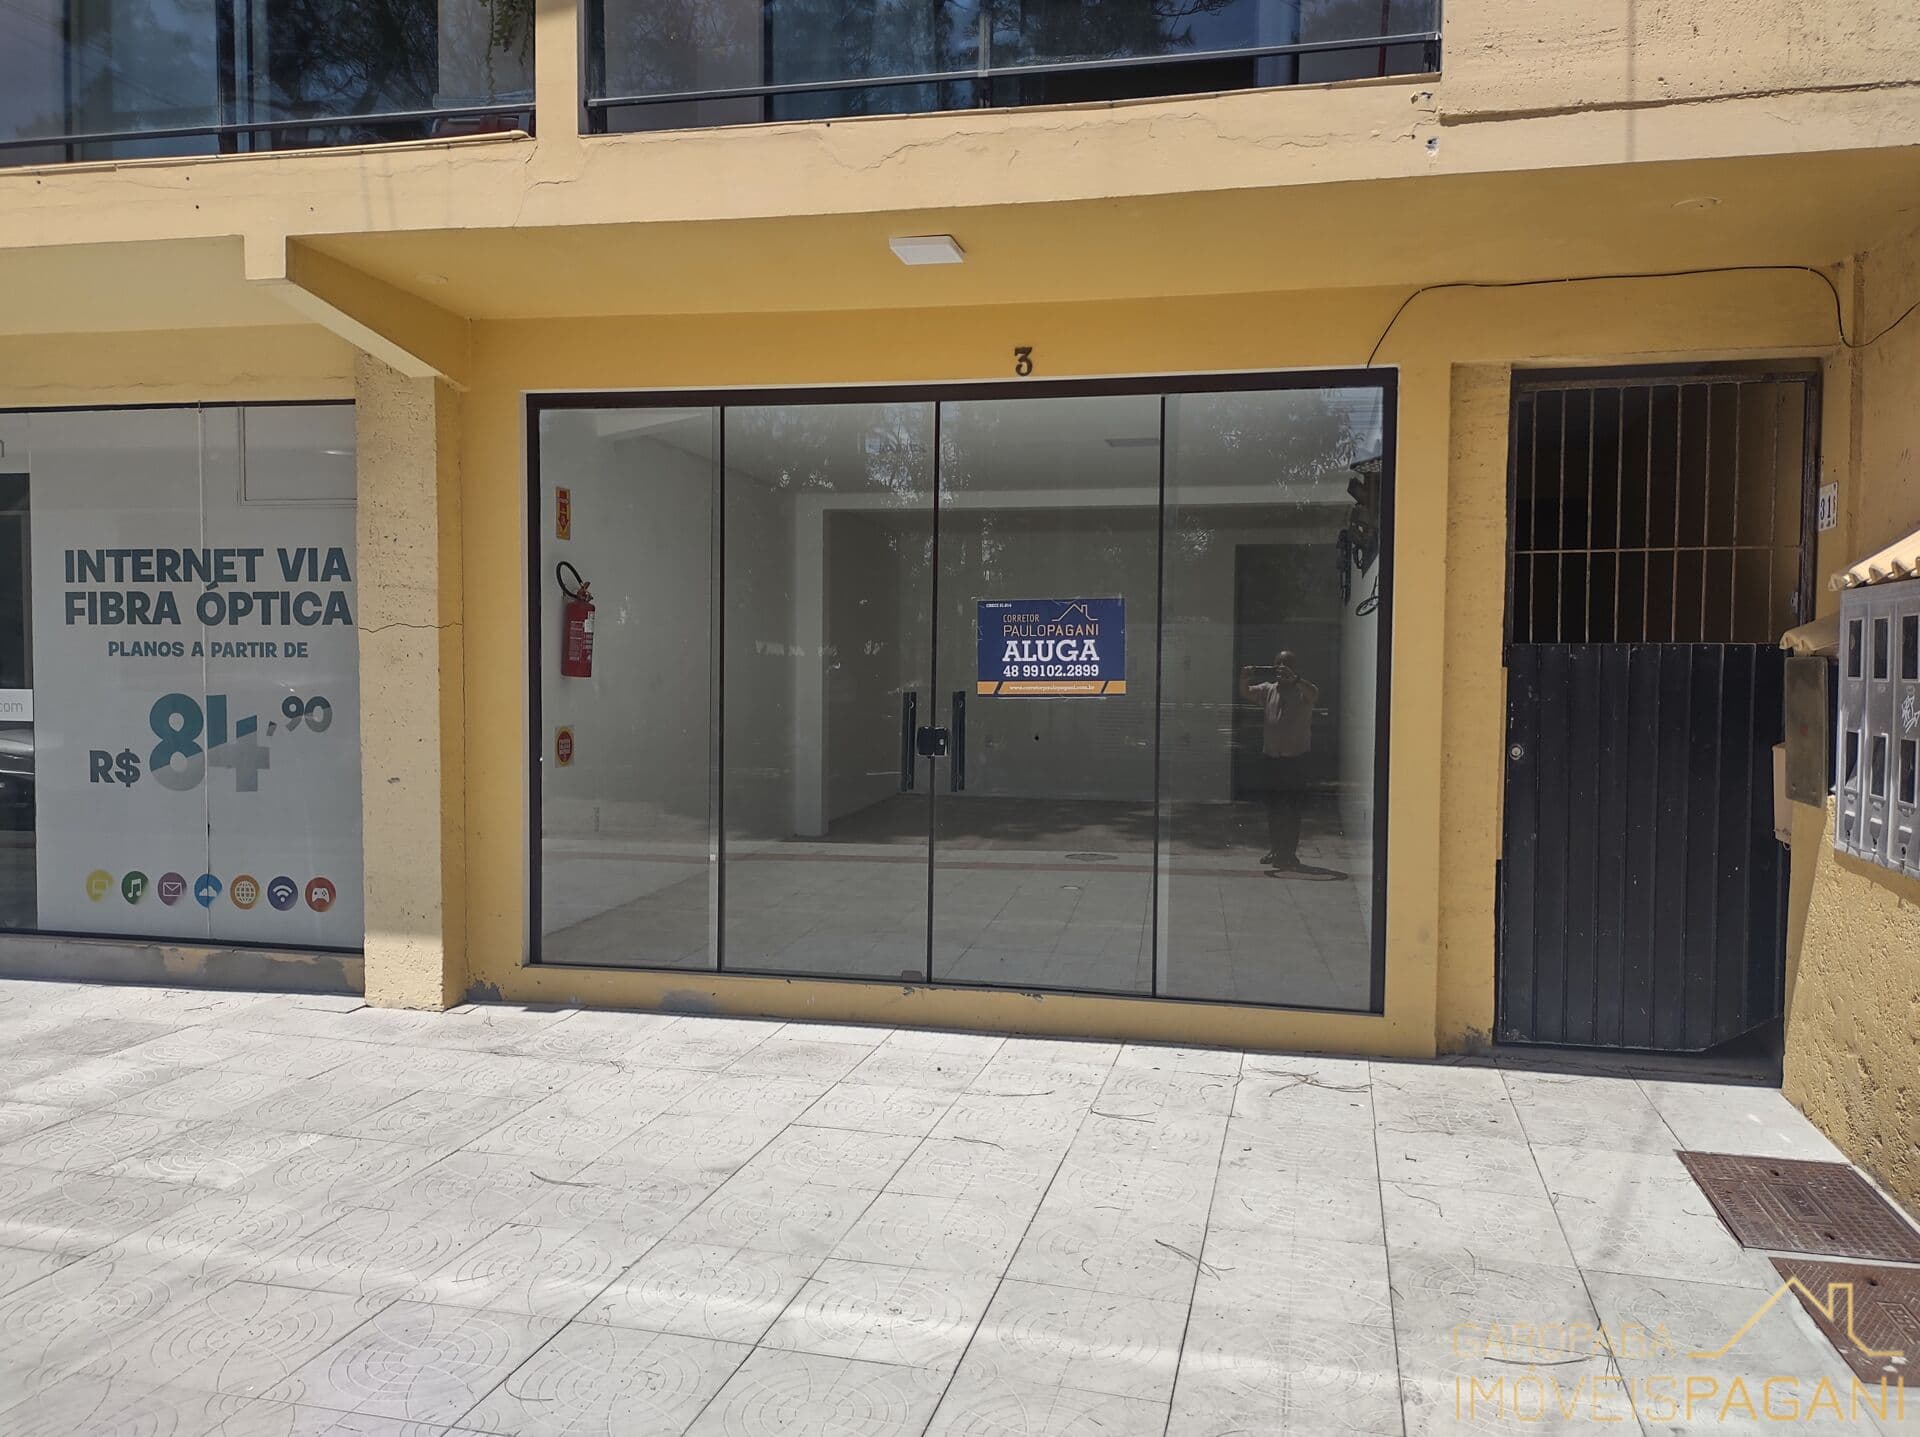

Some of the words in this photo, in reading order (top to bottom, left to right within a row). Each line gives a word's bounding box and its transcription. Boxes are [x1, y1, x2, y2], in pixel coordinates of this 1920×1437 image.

[1014, 346, 1033, 377] 3
[65, 548, 264, 584] INTERNET
[277, 547, 352, 583] VIA
[65, 591, 181, 625] FIBRA
[196, 580, 353, 626] ÓPTICA
[1003, 614, 1040, 623] CORRETOR
[1003, 624, 1099, 637] PAULOPAGANI
[108, 641, 184, 657] PLANOS
[191, 641, 205, 657] A
[211, 641, 278, 658] PARTIR
[284, 642, 308, 658] DE
[1002, 639, 1100, 662] ALUGA
[1003, 665, 1019, 677] 48
[1023, 664, 1099, 677] 99102.2899
[89, 748, 141, 788] R$
